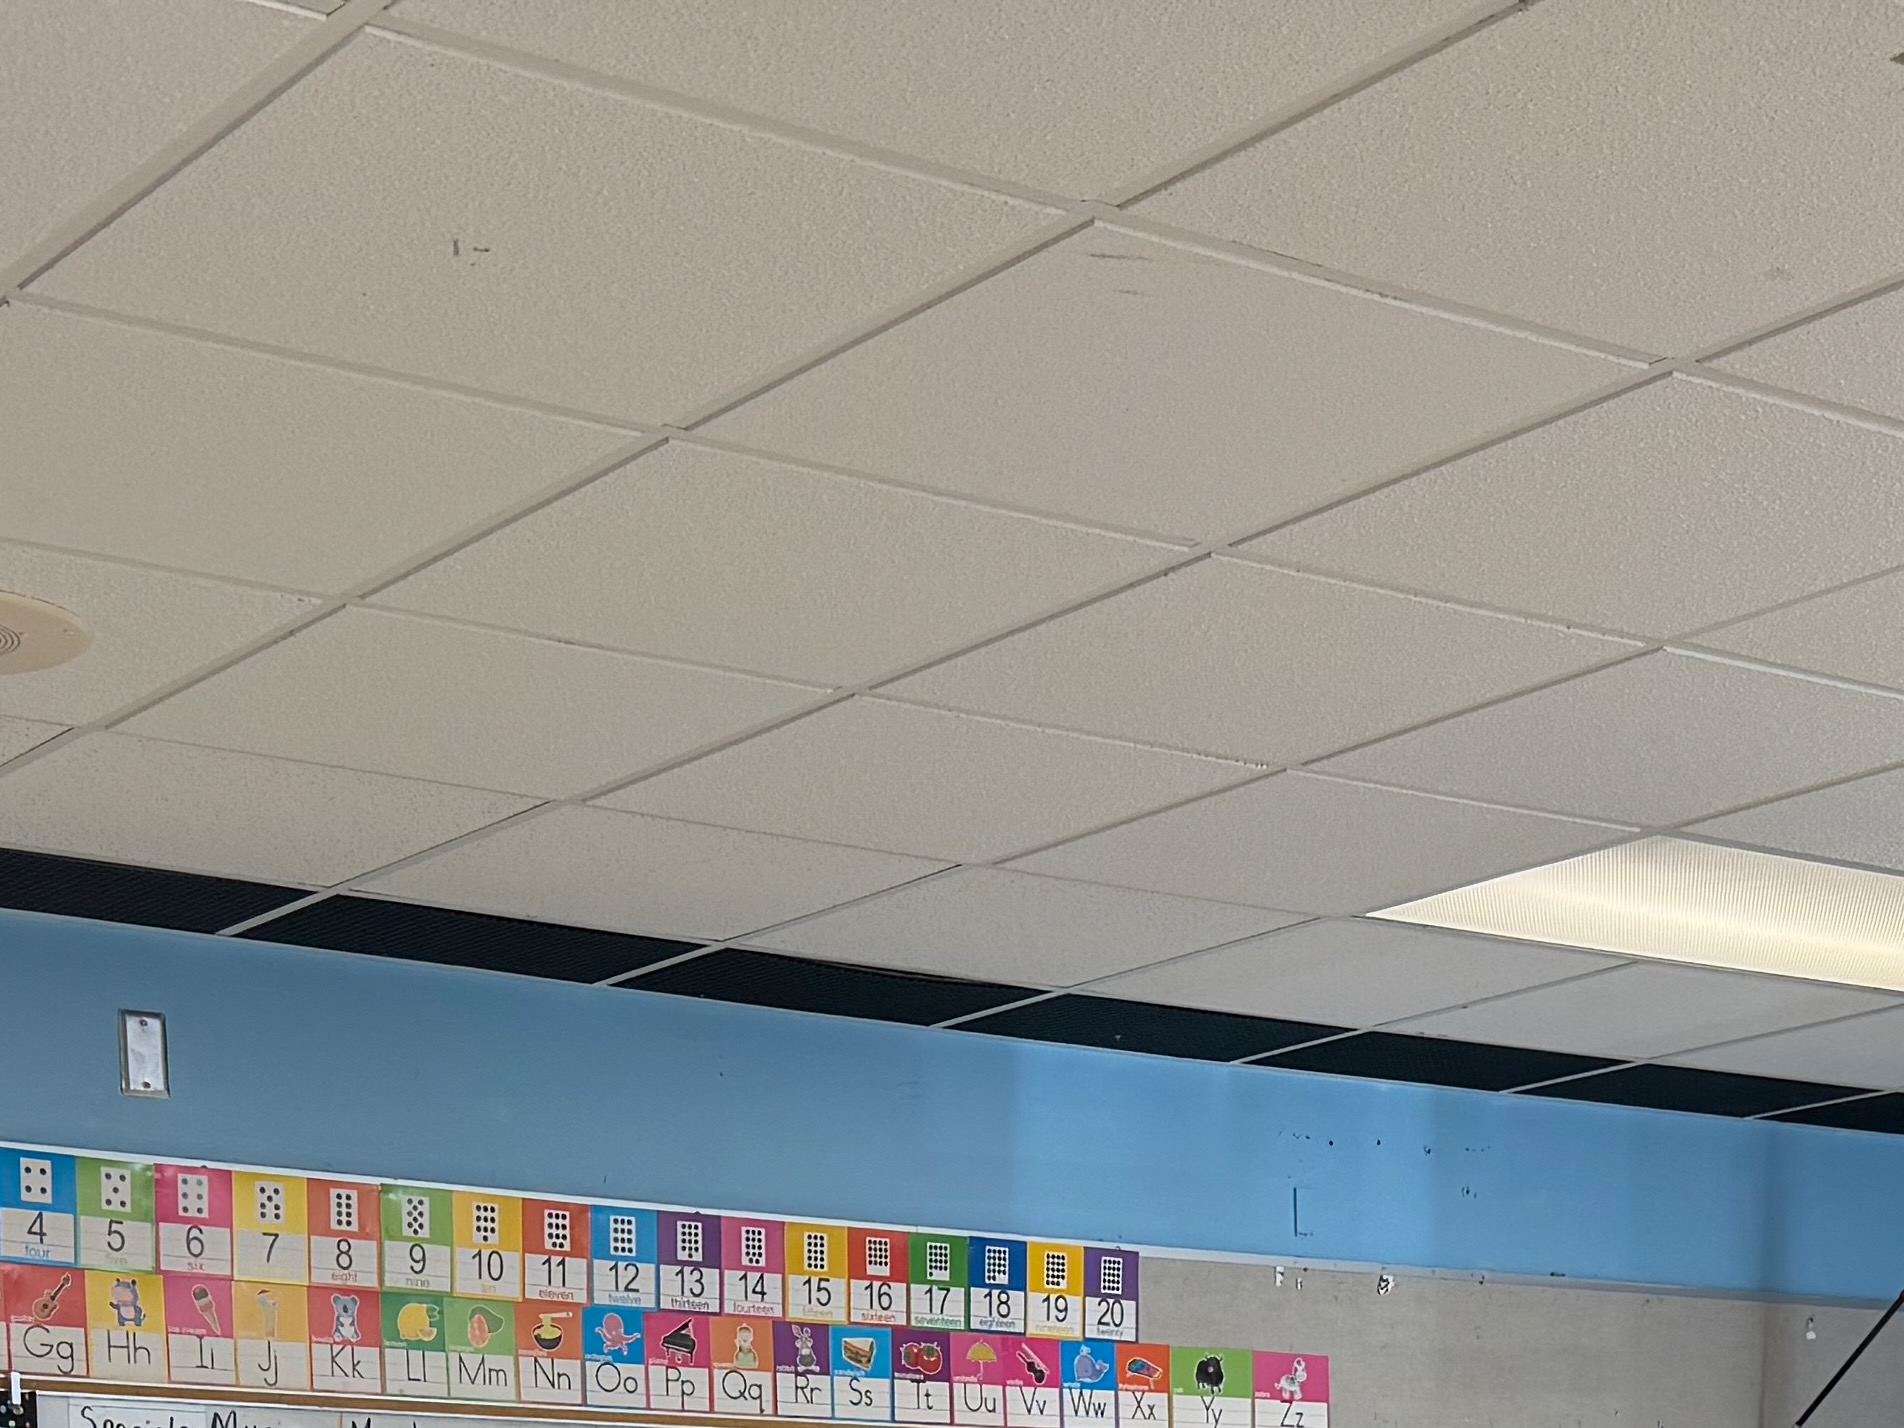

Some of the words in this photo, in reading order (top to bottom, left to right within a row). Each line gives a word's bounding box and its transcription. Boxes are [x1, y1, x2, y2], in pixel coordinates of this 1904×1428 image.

[27, 1212, 46, 1243] 4
[185, 1227, 204, 1257] 6
[335, 1240, 353, 1269] 8
[472, 1250, 504, 1281] 10
[542, 1257, 567, 1287] 11
[676, 1268, 704, 1298] 13
[803, 1276, 830, 1306] 15
[926, 1287, 949, 1314] 17
[1097, 1299, 1123, 1327] 20
[24, 1326, 74, 1373] Gg
[108, 1330, 150, 1365] Hh
[330, 1346, 364, 1380] Kk
[459, 1354, 507, 1388] Mm
[596, 1363, 637, 1395] Oo
[664, 1366, 695, 1410] Pp
[850, 1379, 872, 1407] Ss
[1069, 1390, 1105, 1418] Ww
[1281, 1400, 1304, 1428] Zz
